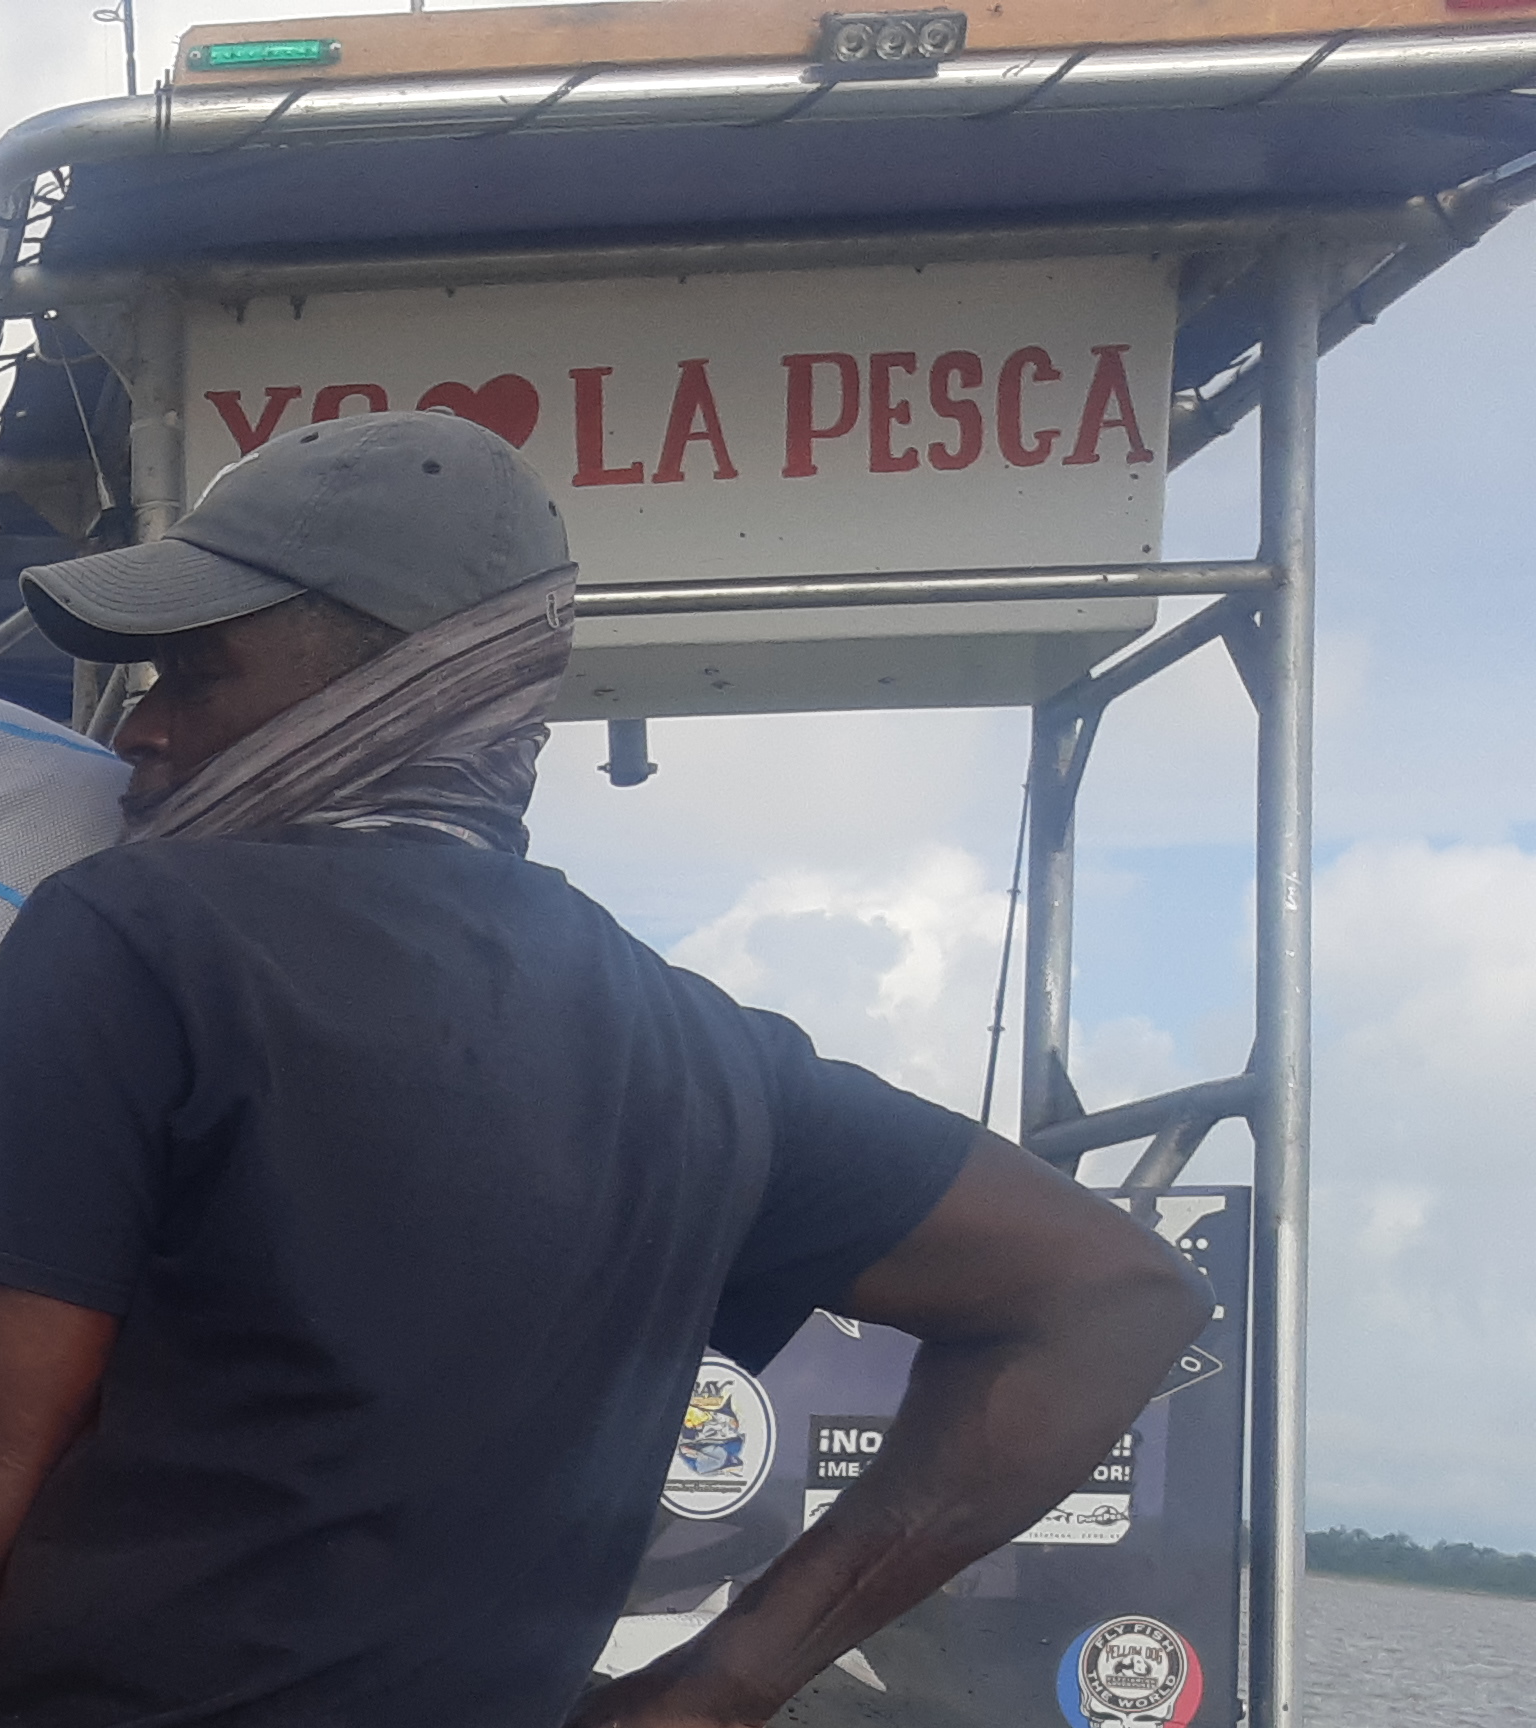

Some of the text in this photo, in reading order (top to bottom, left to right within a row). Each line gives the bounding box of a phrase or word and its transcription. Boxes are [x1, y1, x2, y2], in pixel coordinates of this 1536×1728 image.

[569, 358, 739, 487] LA
[781, 344, 1155, 478] PESCA
[1095, 1623, 1175, 1653] FLY FISH
[1106, 1644, 1163, 1666] YELLOW DOG
[1088, 1670, 1176, 1708] THE WORLD
